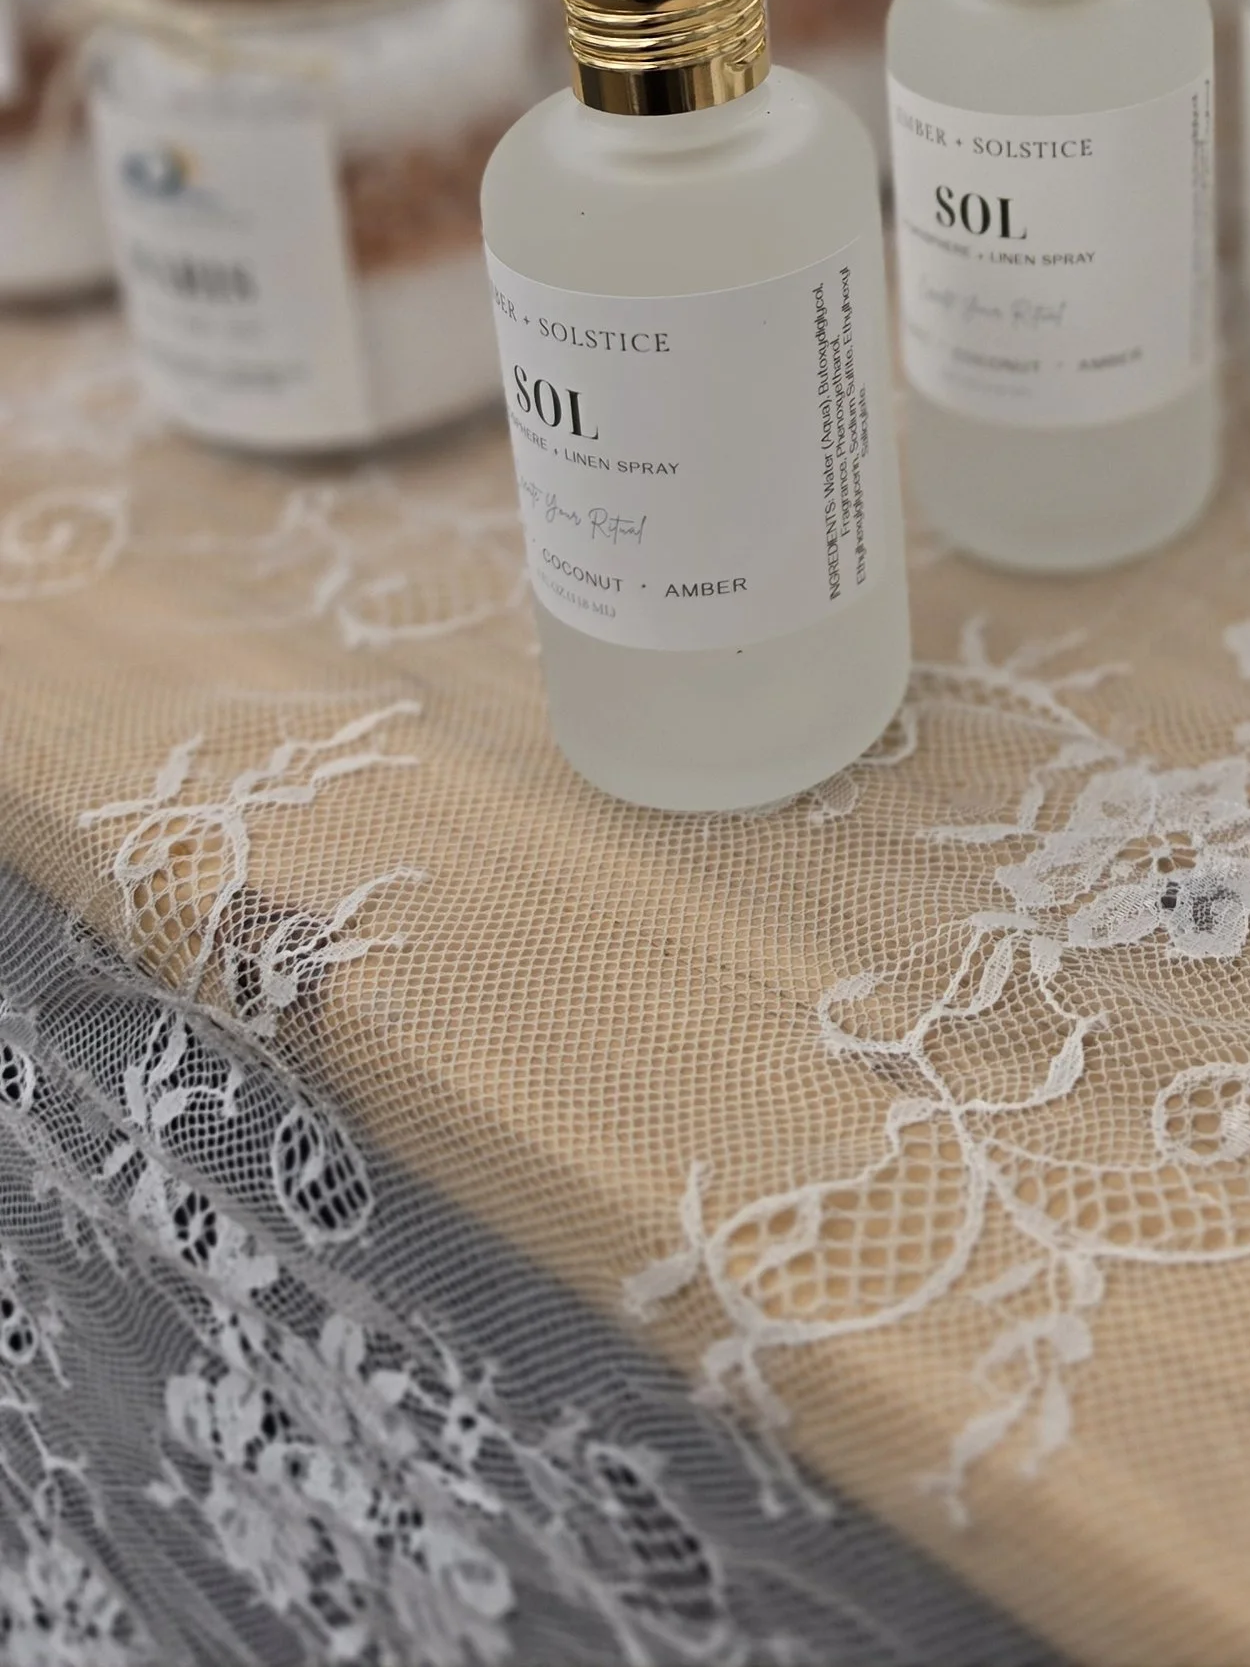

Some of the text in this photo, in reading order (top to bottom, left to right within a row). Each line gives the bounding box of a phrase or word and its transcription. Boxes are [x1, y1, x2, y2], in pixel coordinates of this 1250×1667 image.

[973, 137, 1093, 158] SOLSTICE
[935, 185, 1028, 240] SOL
[990, 252, 1036, 267] LINEN
[1041, 251, 1096, 267] SPRAY
[539, 317, 670, 353] SOLSTICE
[514, 364, 599, 440] SOL
[846, 396, 859, 454] Sodium
[564, 446, 610, 471] LINEN
[617, 460, 680, 475] SPRAY
[822, 452, 836, 499] Water
[545, 492, 582, 524] Your
[588, 507, 648, 546] Ritual
[542, 547, 625, 594] COCONUT
[664, 576, 748, 598] AMBER
[824, 498, 842, 601] INGREDIENTS:
